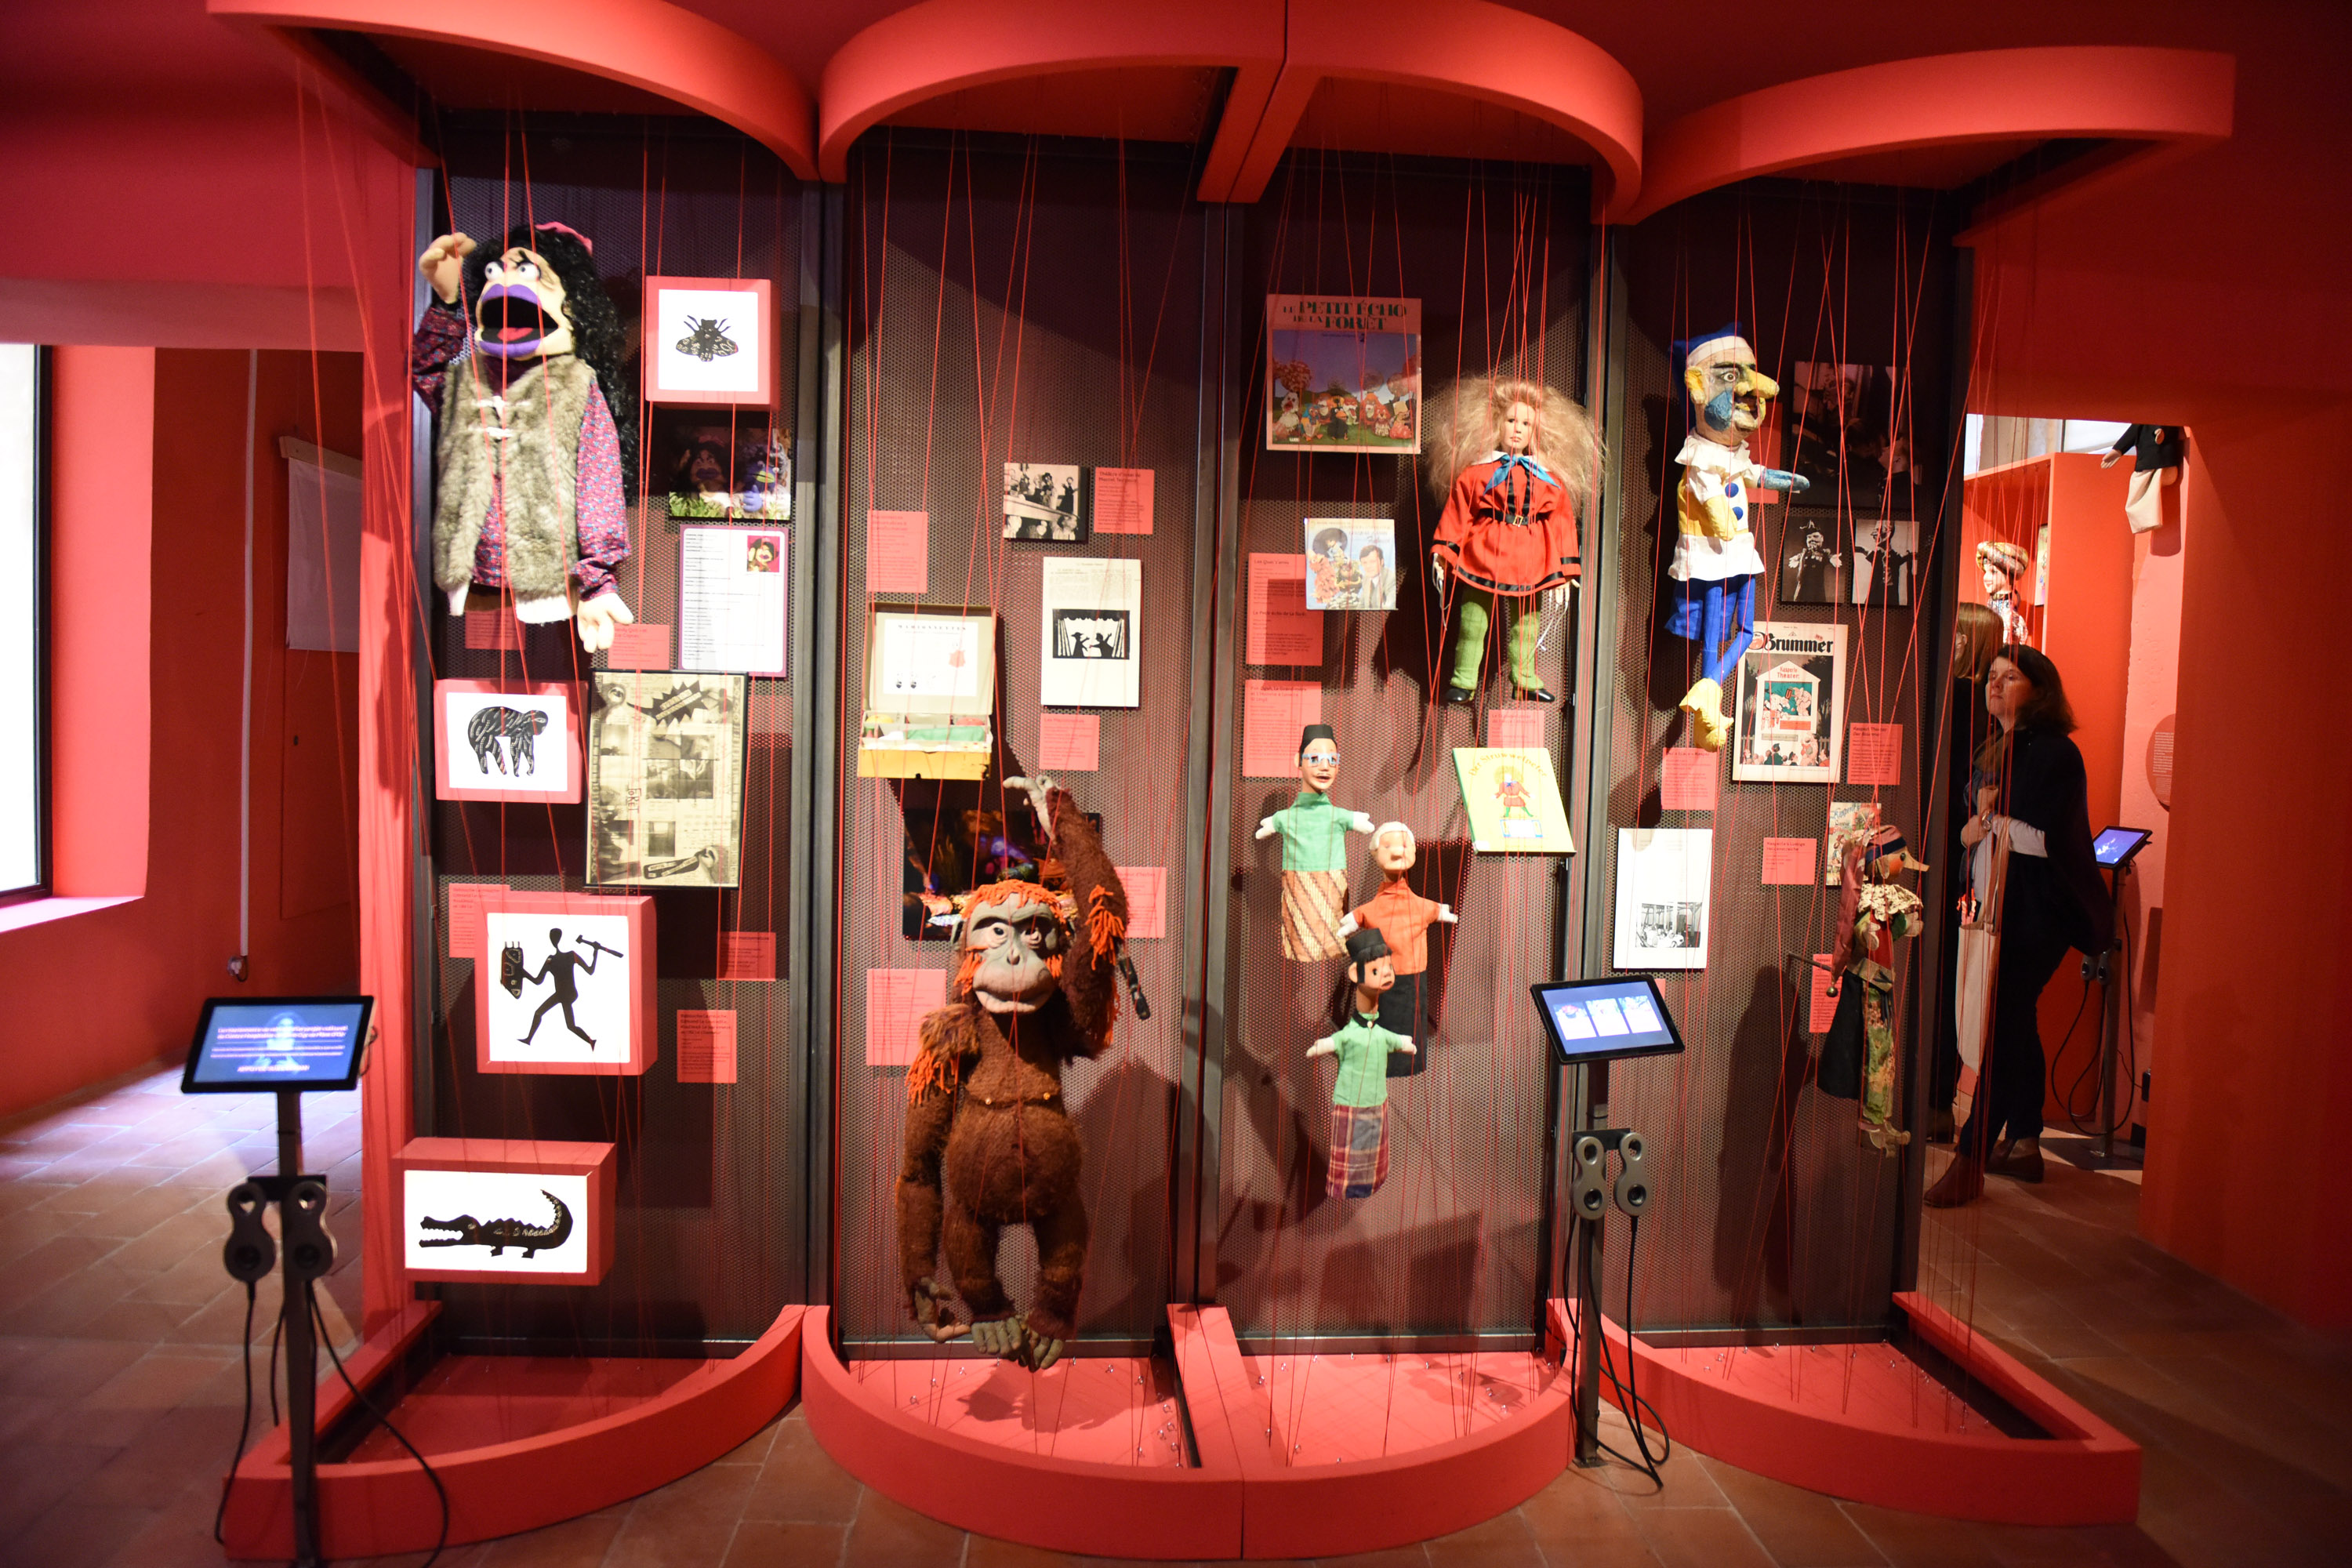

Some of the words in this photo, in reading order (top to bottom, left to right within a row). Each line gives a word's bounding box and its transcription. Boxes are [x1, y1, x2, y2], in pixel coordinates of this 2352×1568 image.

[1298, 300, 1354, 315] PETIT
[1356, 299, 1408, 318] ÉCHO
[1749, 631, 1834, 654] Brummer
[1468, 761, 1482, 776] Der
